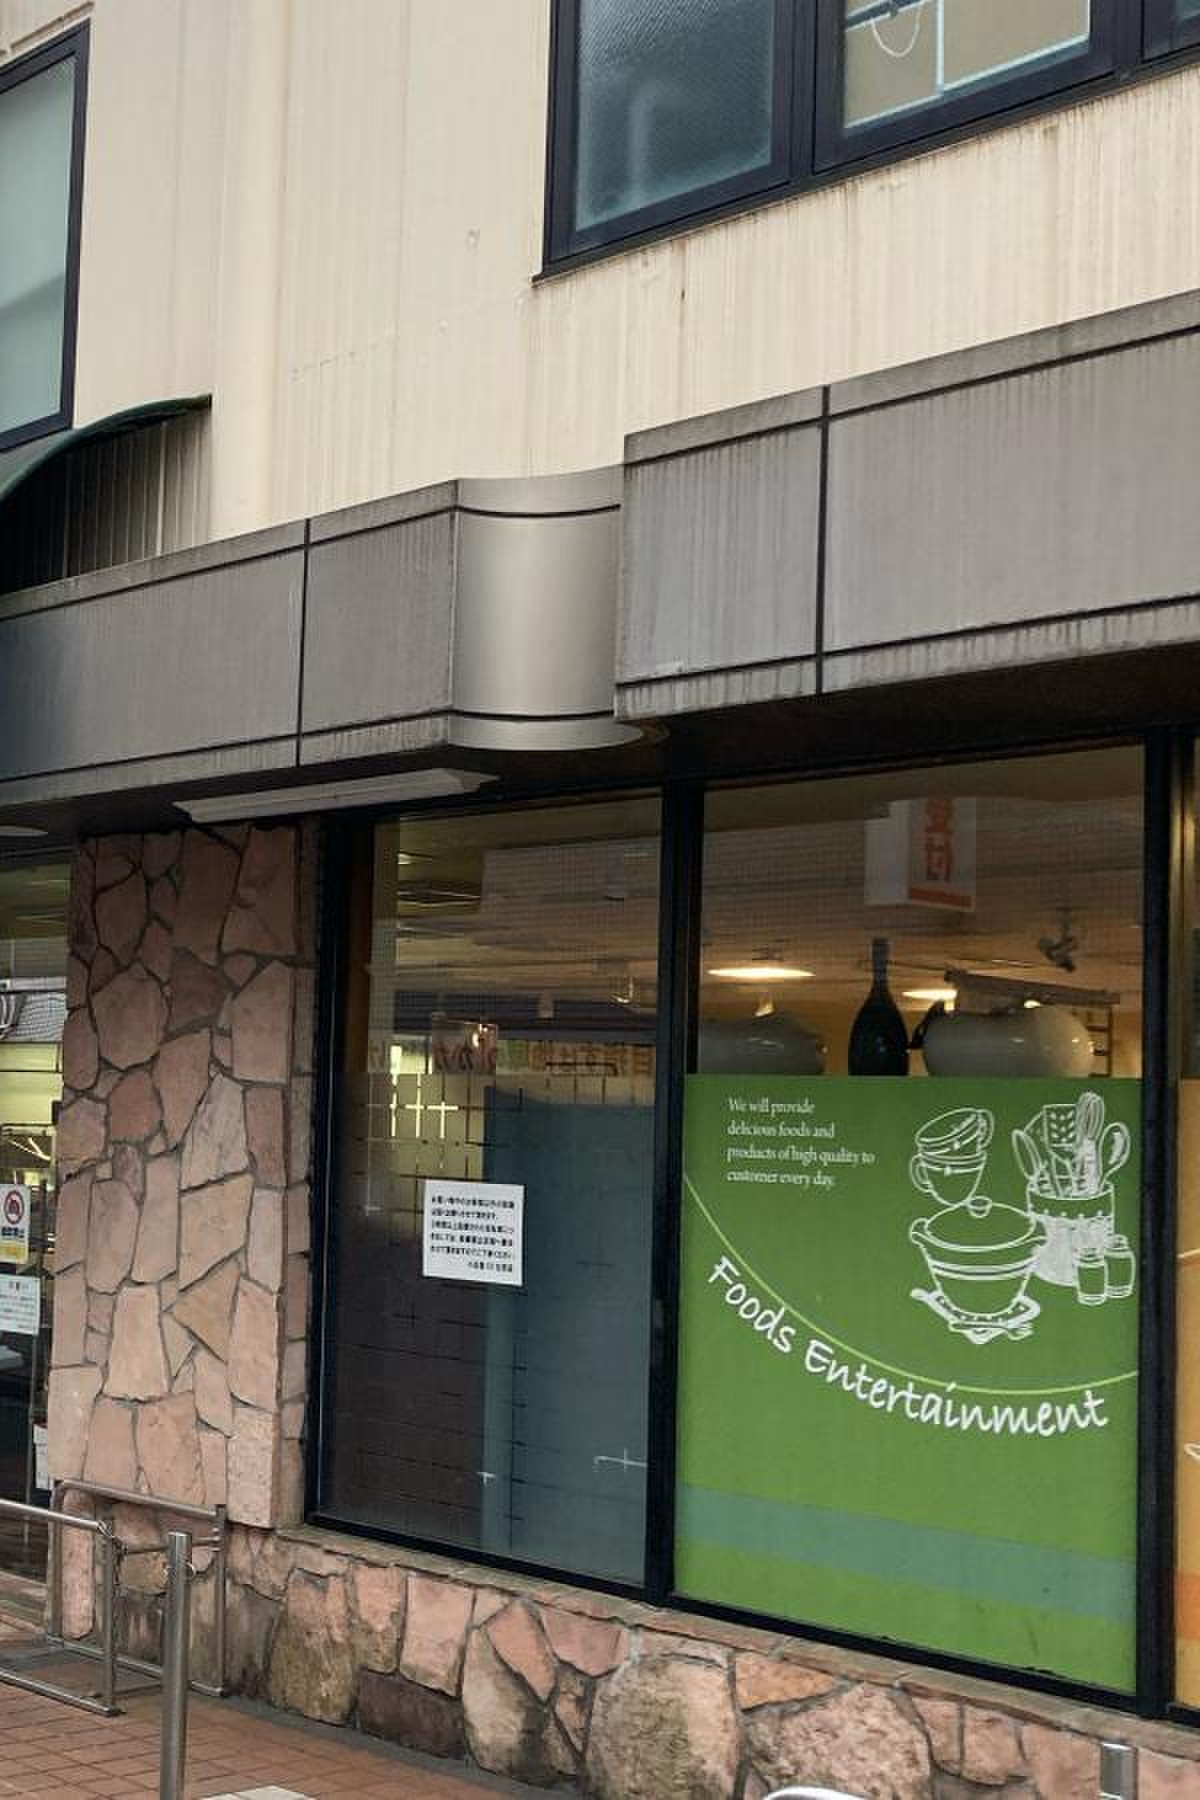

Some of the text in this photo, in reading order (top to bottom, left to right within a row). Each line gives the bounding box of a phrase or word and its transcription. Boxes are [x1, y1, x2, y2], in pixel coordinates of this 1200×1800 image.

[728, 1098, 815, 1117] We will provide
[727, 1120, 835, 1138] delicious foods and
[727, 1144, 875, 1167] products of high quality to
[727, 1170, 778, 1184] customer
[780, 1173, 809, 1188] every
[708, 1255, 1109, 1437] Foods Entertainment
